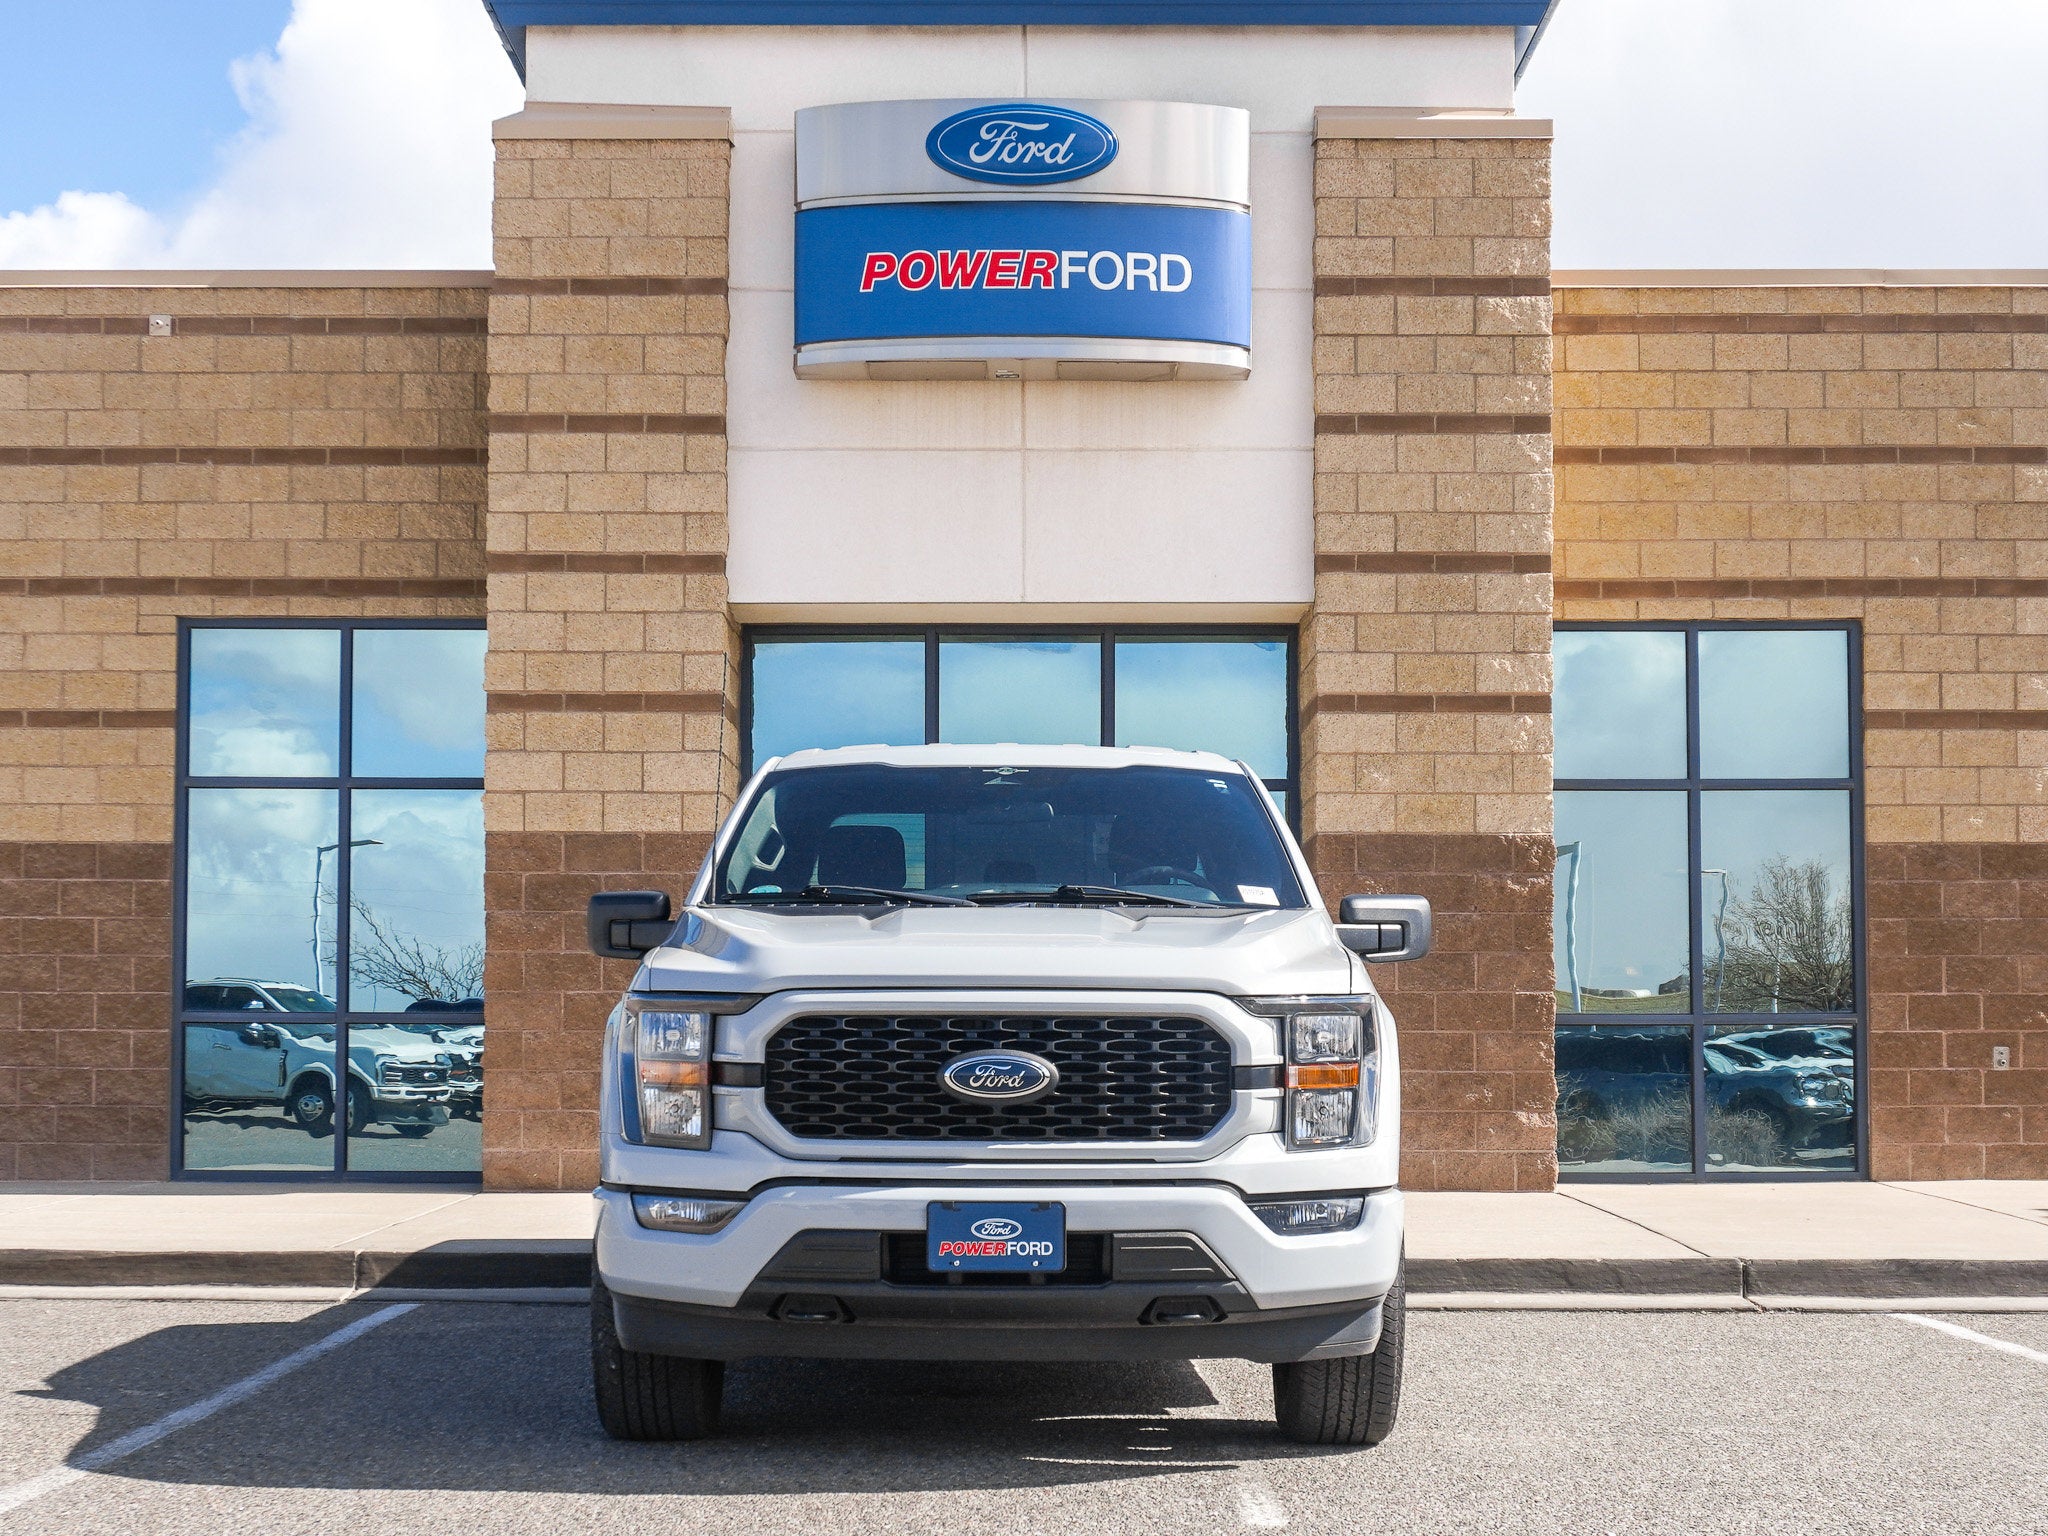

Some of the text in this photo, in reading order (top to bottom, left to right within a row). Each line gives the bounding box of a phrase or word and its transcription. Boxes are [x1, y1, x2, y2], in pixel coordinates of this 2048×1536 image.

[969, 120, 1075, 165] Ford
[969, 1064, 1025, 1089] Ford
[980, 1222, 1012, 1236] Ford
